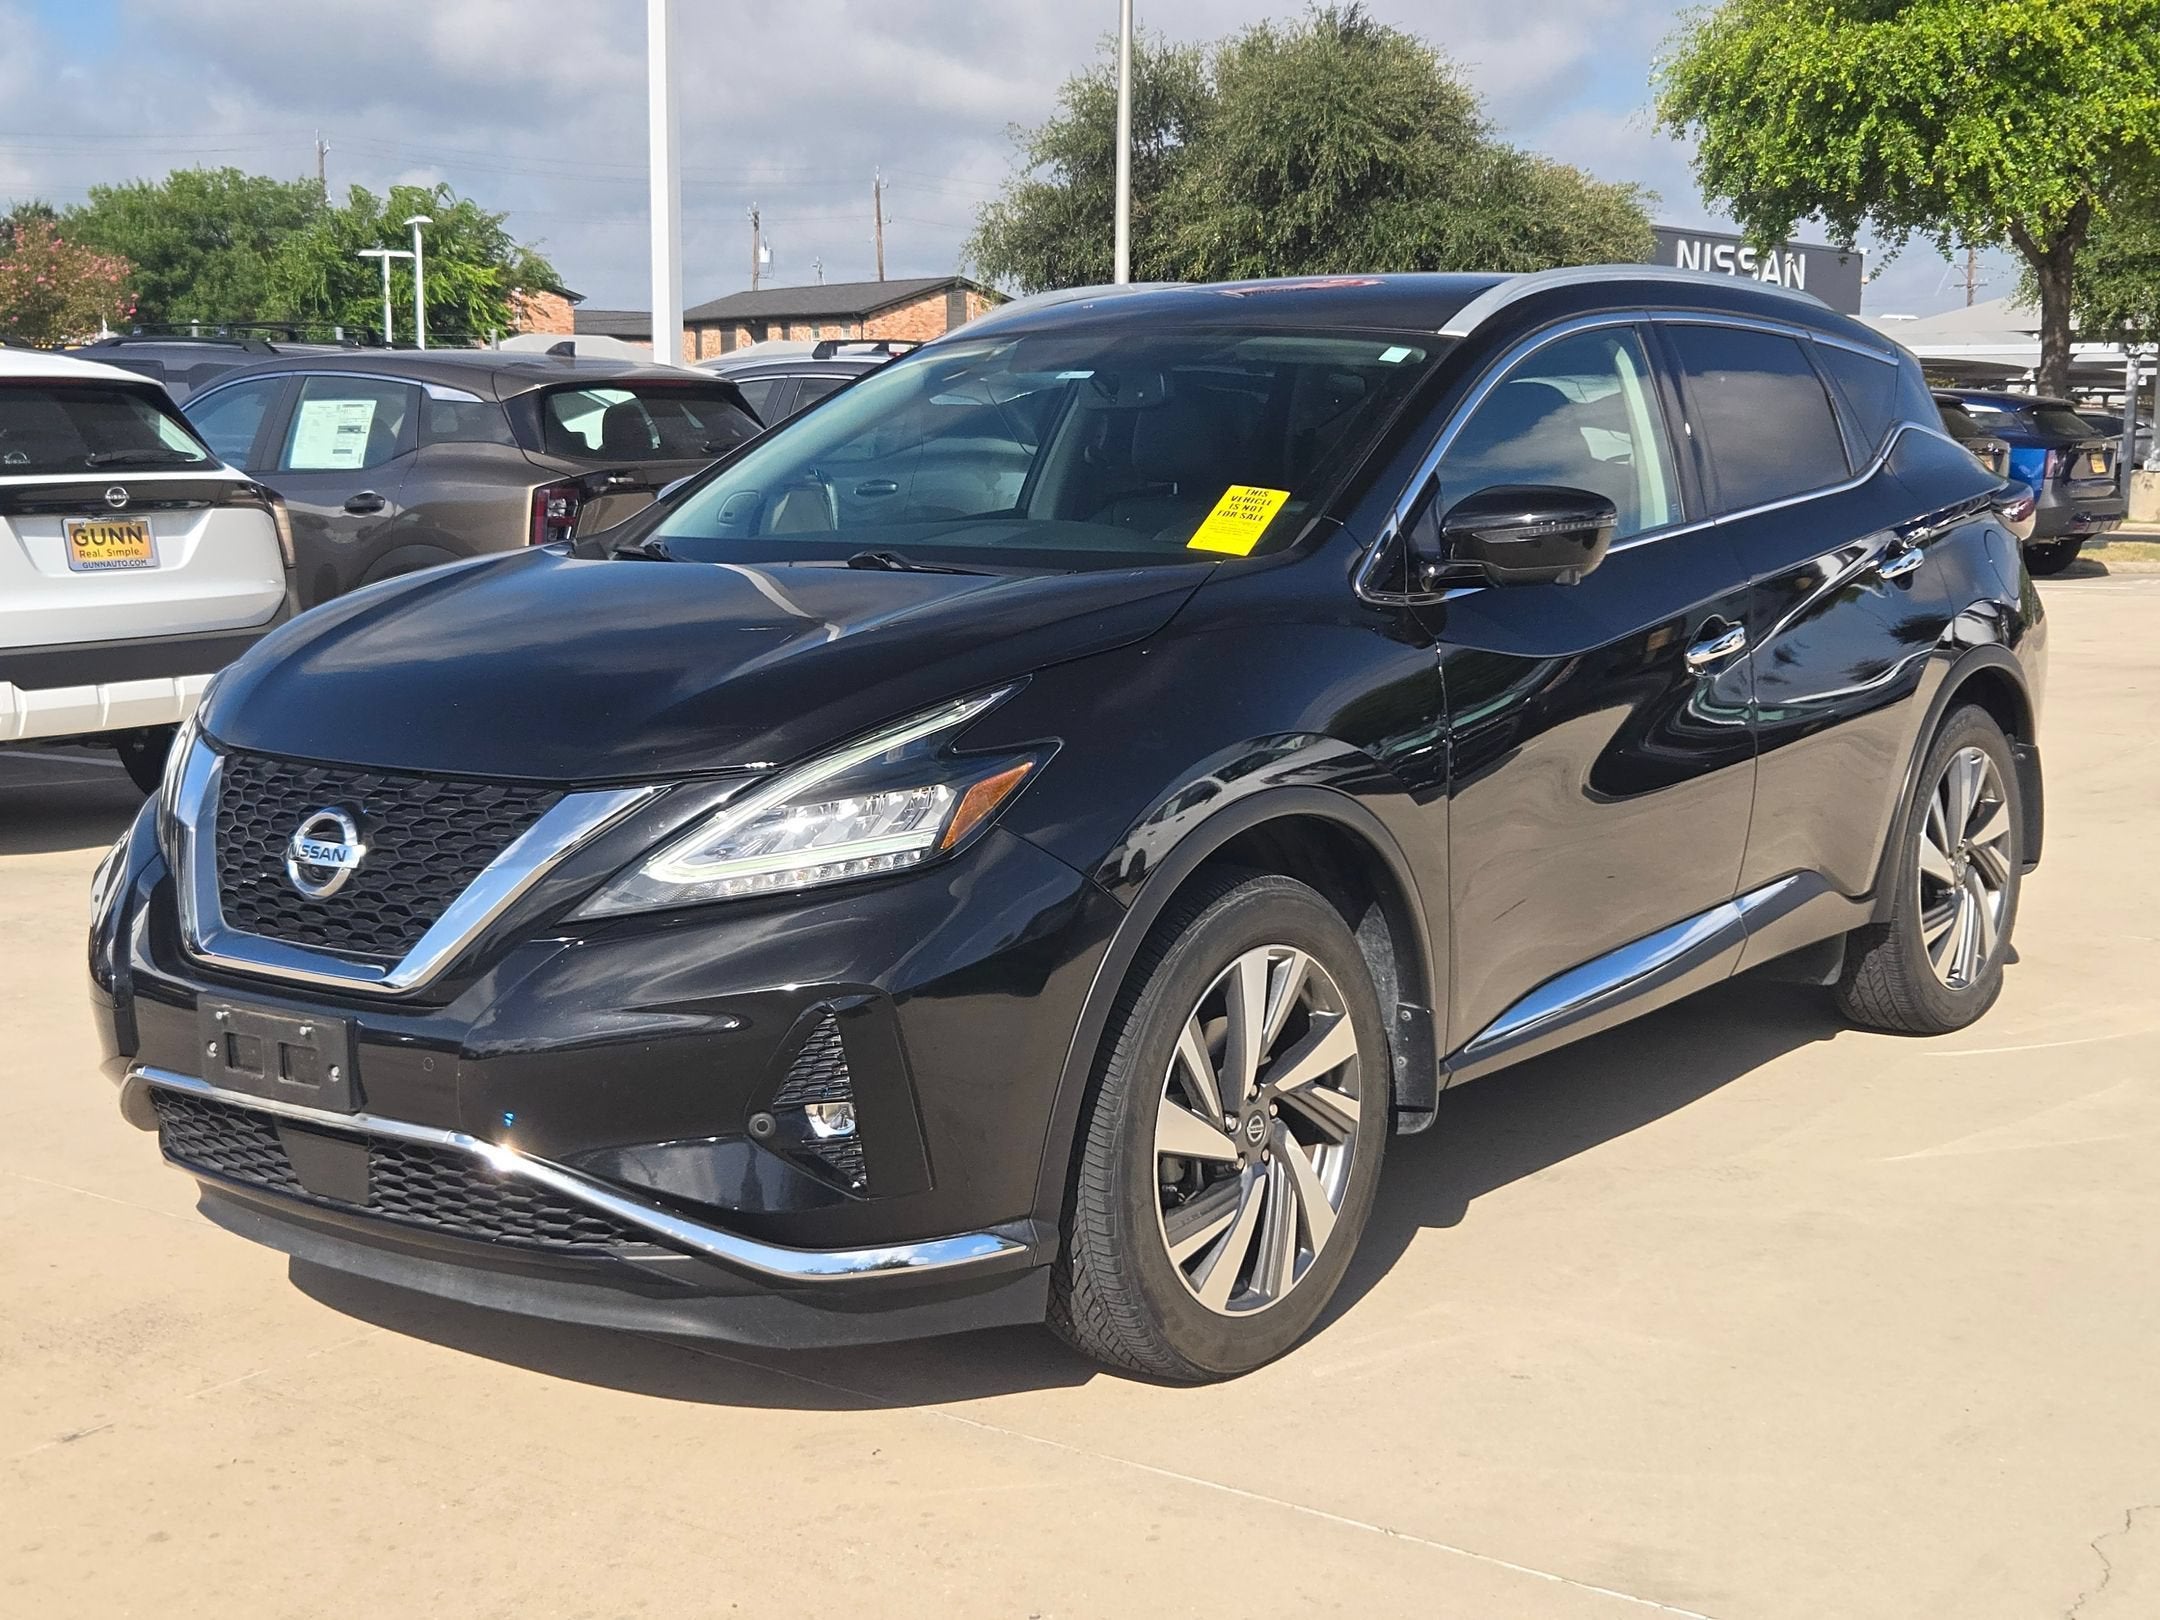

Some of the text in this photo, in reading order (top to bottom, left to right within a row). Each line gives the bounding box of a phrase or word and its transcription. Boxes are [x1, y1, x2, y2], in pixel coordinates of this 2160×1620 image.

[1676, 239, 1806, 290] NISSAN
[1245, 489, 1270, 498] THIS
[1231, 495, 1272, 506] VEHICLE
[1229, 503, 1241, 511] IS
[72, 526, 144, 547] GUNN
[79, 547, 143, 559] Real. Simple.
[82, 559, 148, 569] GUNNAUTO.COM
[287, 842, 347, 862] NISSAN
